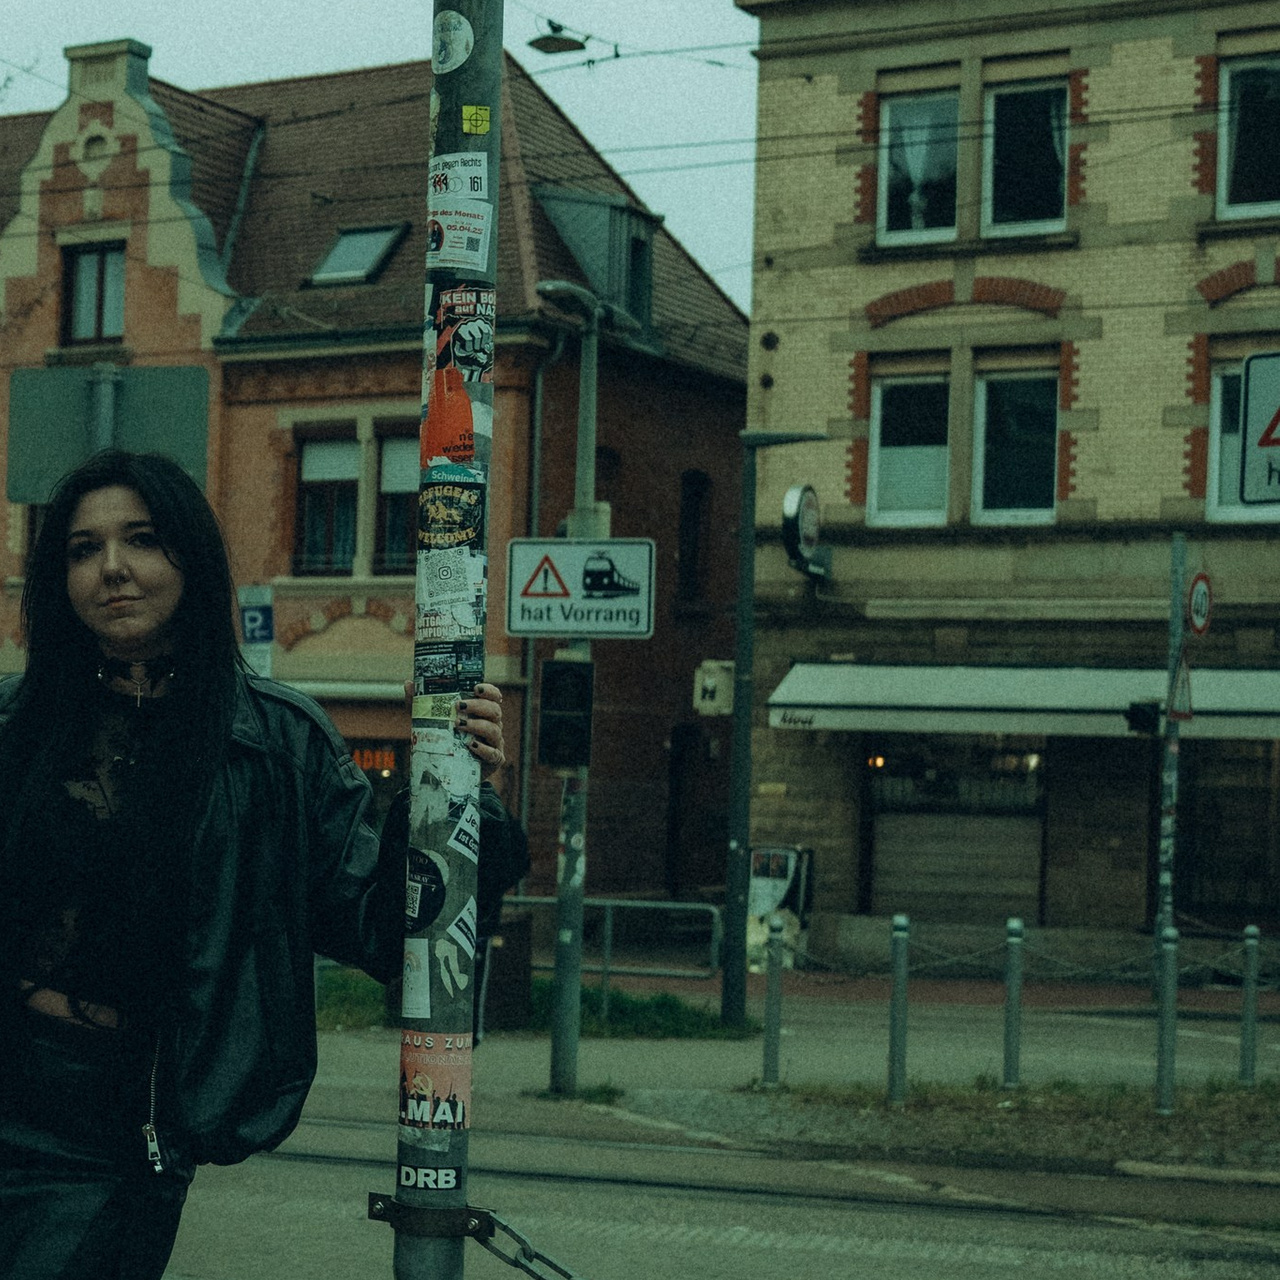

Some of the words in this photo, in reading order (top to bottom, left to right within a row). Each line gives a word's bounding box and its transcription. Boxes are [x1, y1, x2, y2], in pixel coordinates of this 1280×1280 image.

[460, 158, 482, 167] Rechts
[469, 176, 482, 192] 161
[454, 210, 485, 220] Monats
[442, 291, 477, 305] KEIN
[455, 304, 475, 314] auf
[418, 486, 478, 507] REFUGES
[1194, 591, 1207, 619] 40
[520, 603, 552, 621] hat
[560, 603, 641, 626] Vorrang
[244, 610, 263, 638] P
[352, 748, 396, 771] ADEN
[402, 1034, 434, 1048] AUS
[400, 1165, 457, 1189] DRB
